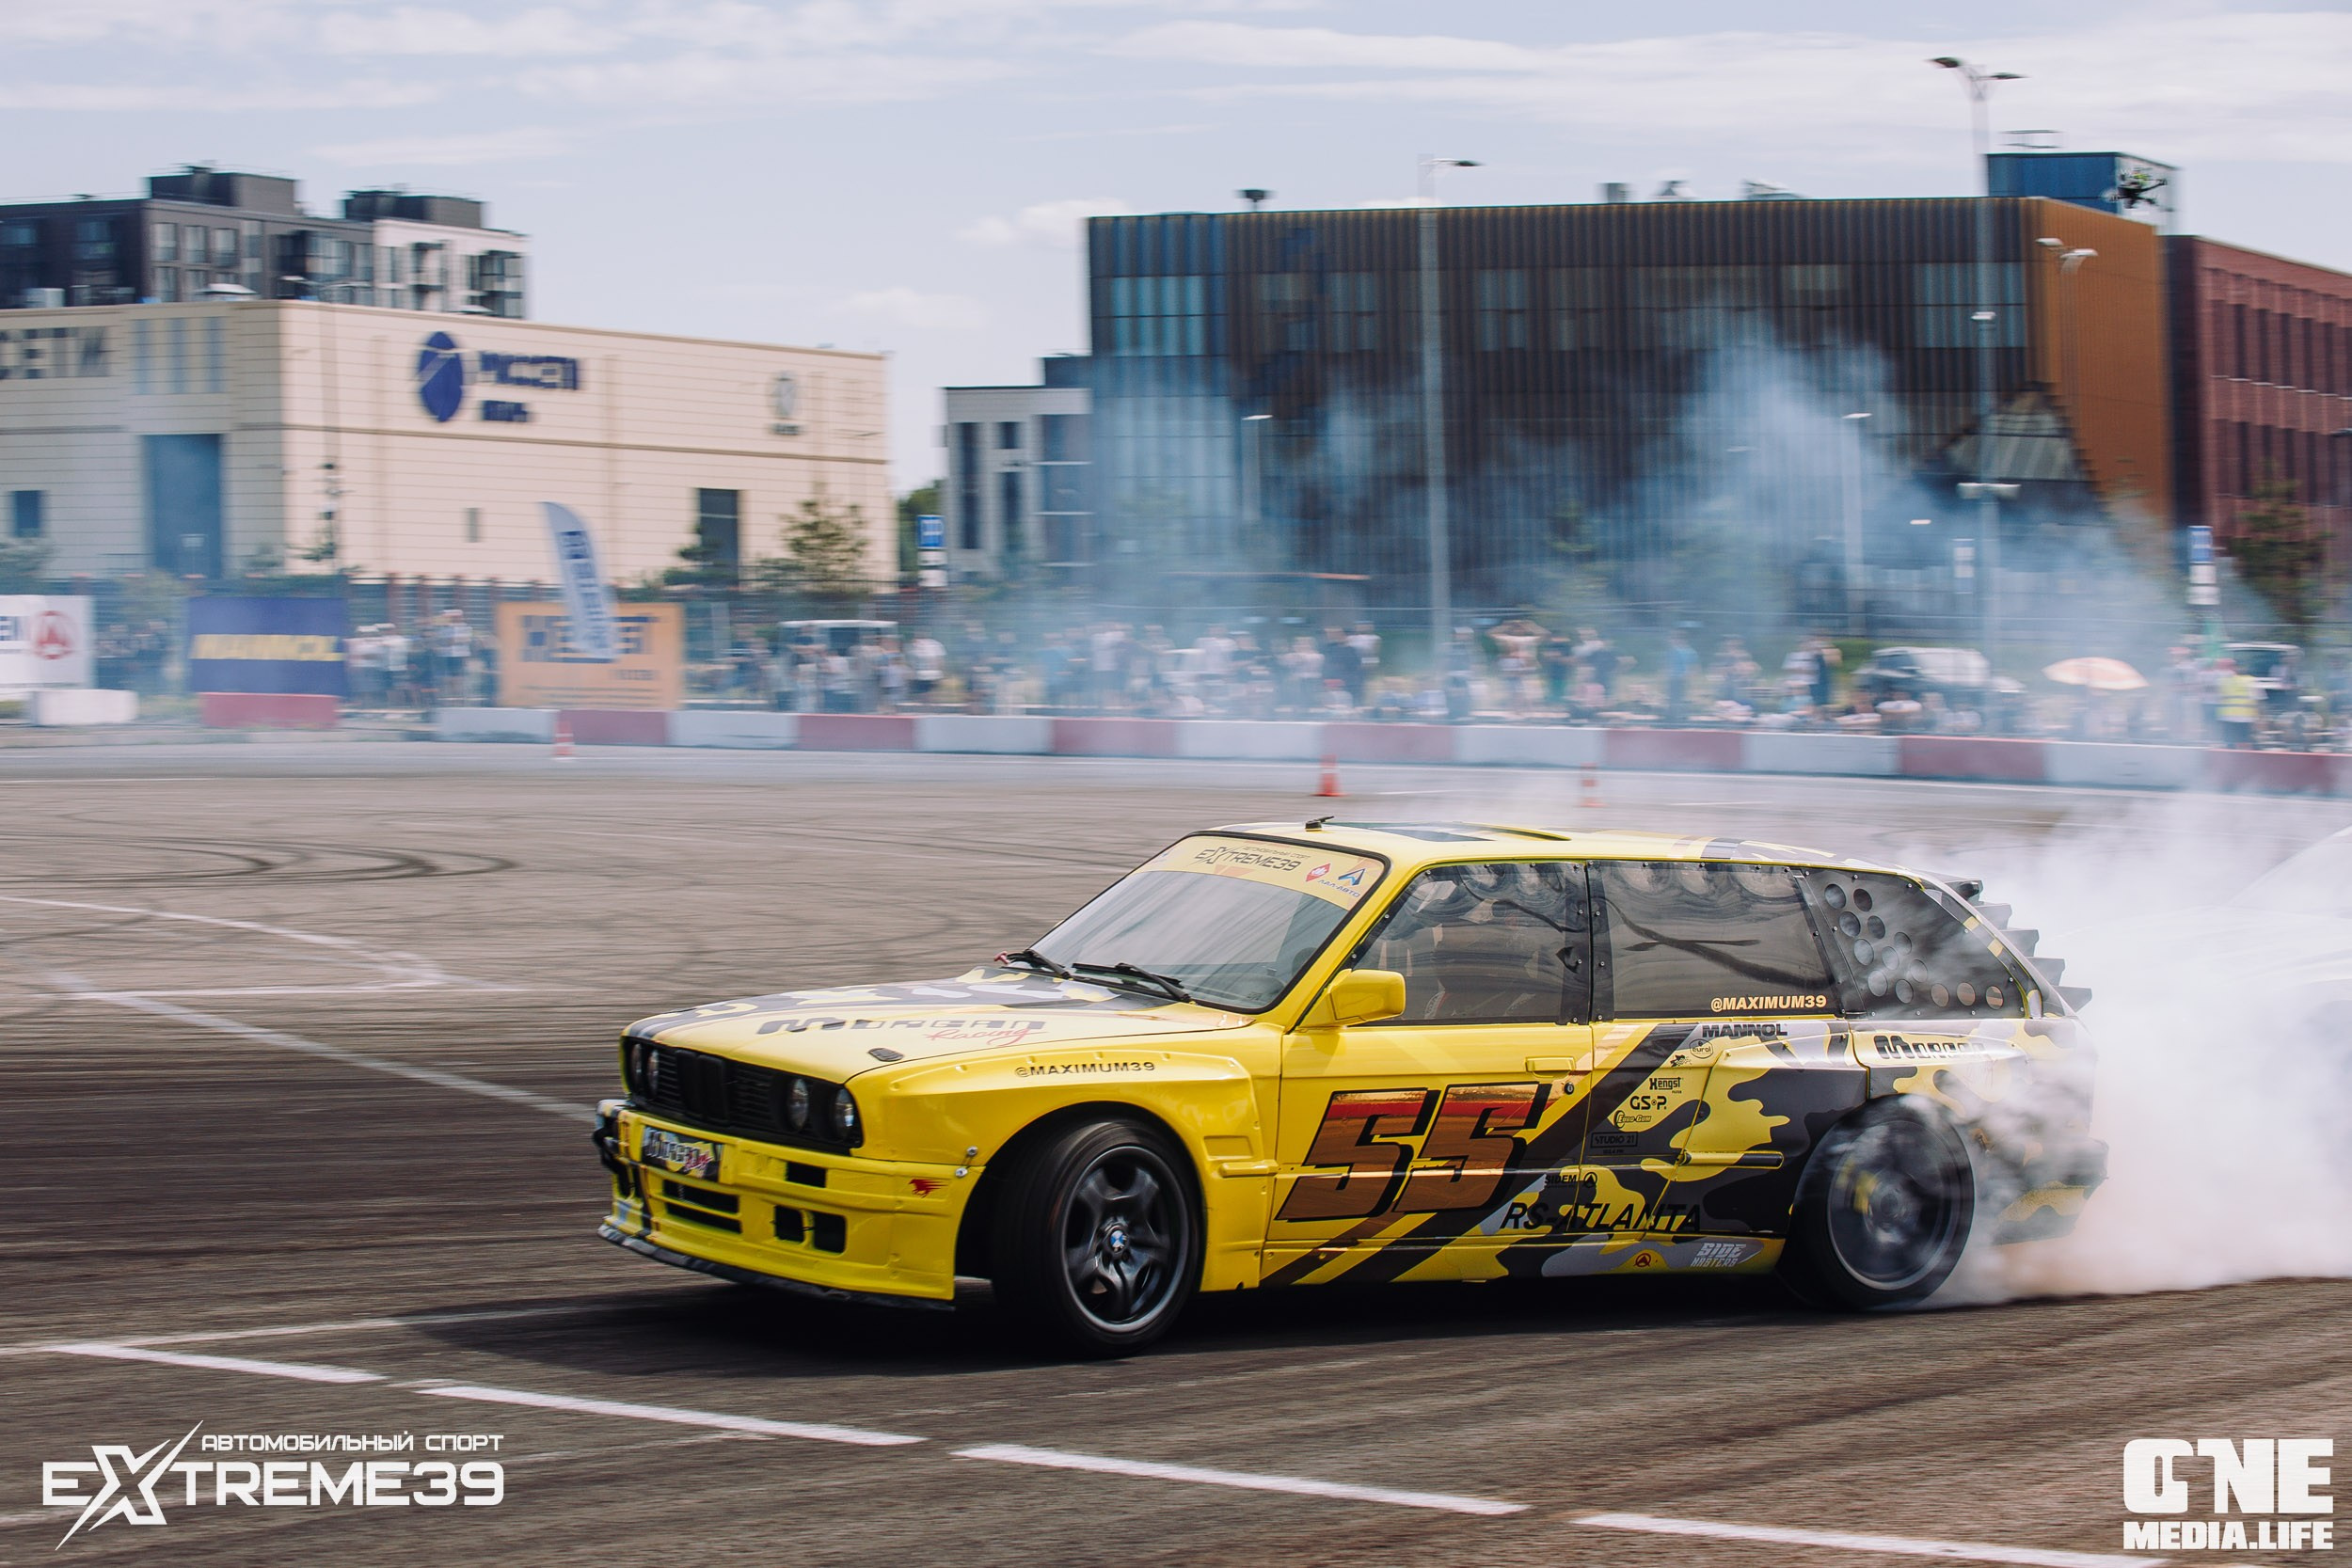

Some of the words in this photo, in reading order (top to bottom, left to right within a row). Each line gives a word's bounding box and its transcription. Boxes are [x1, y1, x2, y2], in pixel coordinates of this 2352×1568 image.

[1191, 847, 1301, 871] EXTREME39
[1710, 995, 1827, 1012] @MAXIMUM39
[926, 1027, 1049, 1047] Racing
[1701, 1023, 1788, 1037] MANNOL
[1014, 1061, 1155, 1078] @MAXIMUM39
[1649, 1077, 1681, 1090] Hengst
[1595, 1135, 1625, 1145] STUDIO
[1626, 1134, 1635, 1144] 21
[1274, 1081, 1552, 1223] 55
[1545, 1174, 1578, 1183] SIDEM
[1696, 1243, 1747, 1258] SIDE
